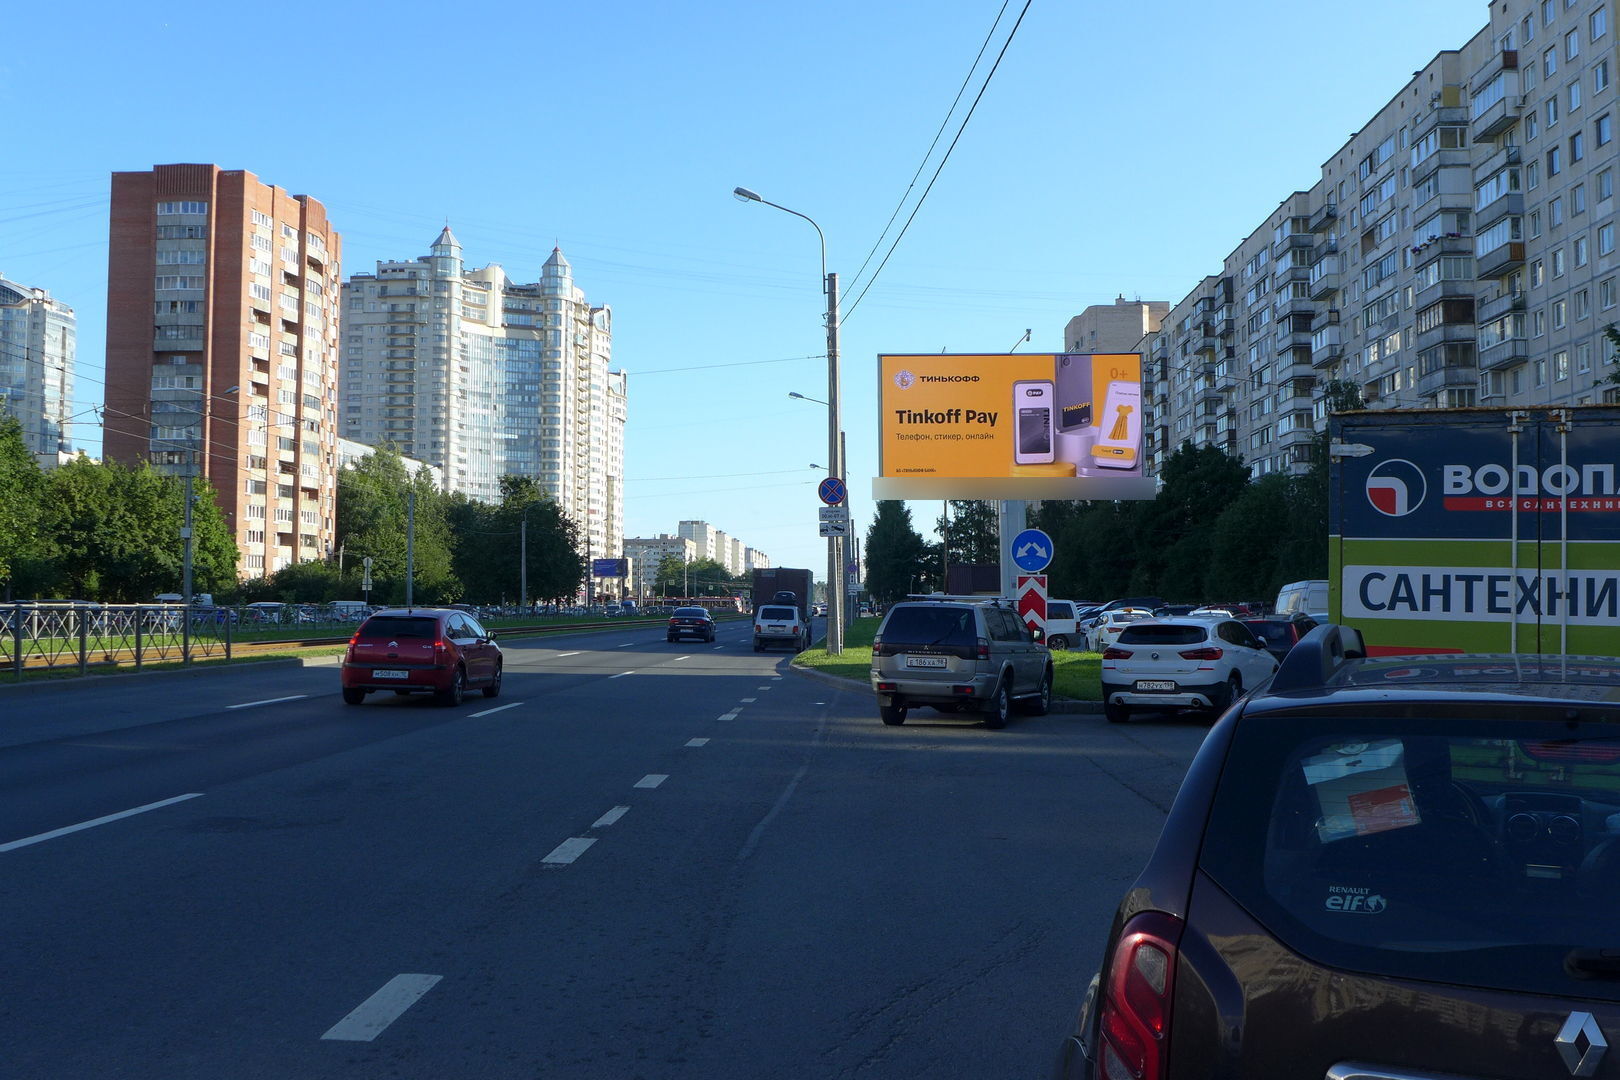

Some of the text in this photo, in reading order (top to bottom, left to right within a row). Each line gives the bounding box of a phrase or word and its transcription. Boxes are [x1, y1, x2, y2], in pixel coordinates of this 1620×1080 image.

[1110, 368, 1128, 379] 0+
[1063, 402, 1091, 412] TINKOFF
[896, 409, 998, 427] Tinkoff Pay
[896, 433, 933, 442] Телефон,
[1443, 464, 1620, 495] ВОДОП
[1359, 572, 1617, 617] САНТЕХНИ
[1329, 886, 1370, 894] RENAULT
[1325, 895, 1365, 911] elf
